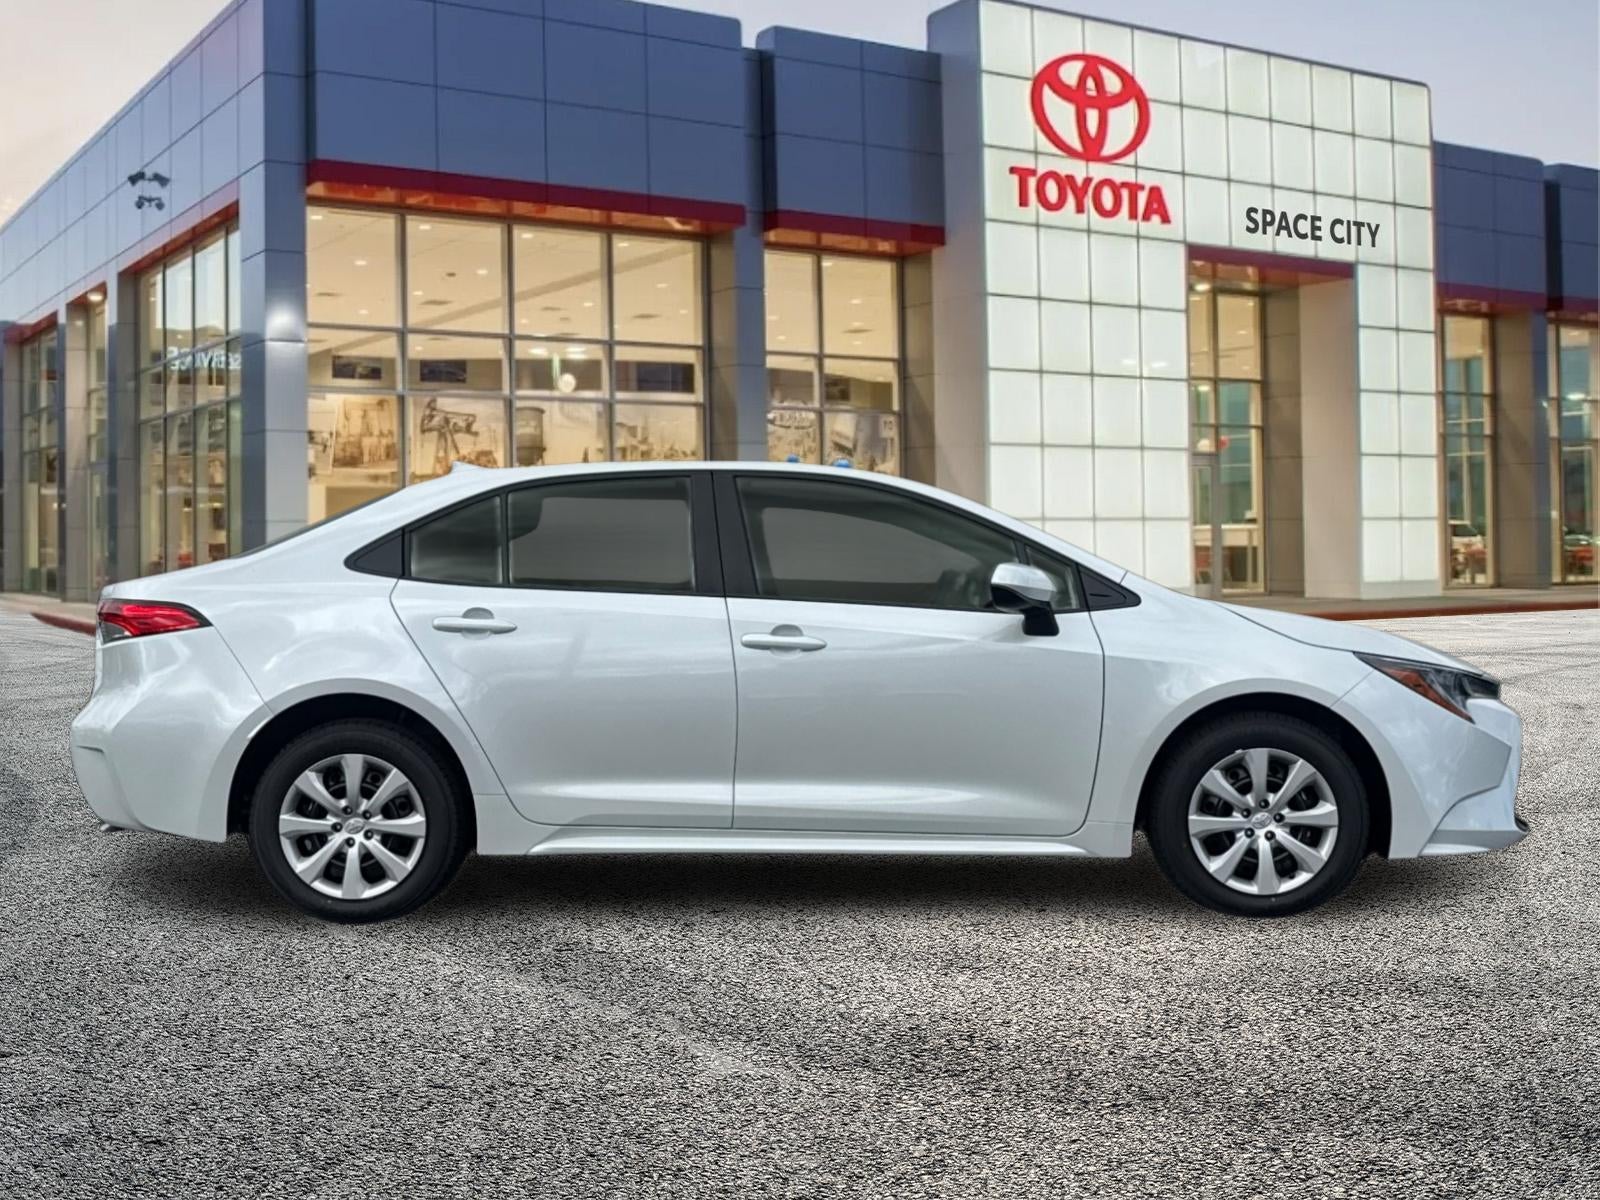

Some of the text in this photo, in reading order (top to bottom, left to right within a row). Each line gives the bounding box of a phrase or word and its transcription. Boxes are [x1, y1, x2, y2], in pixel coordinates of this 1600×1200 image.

[1009, 167, 1171, 224] TOYOTA
[1245, 207, 1380, 248] SPACE CITY
